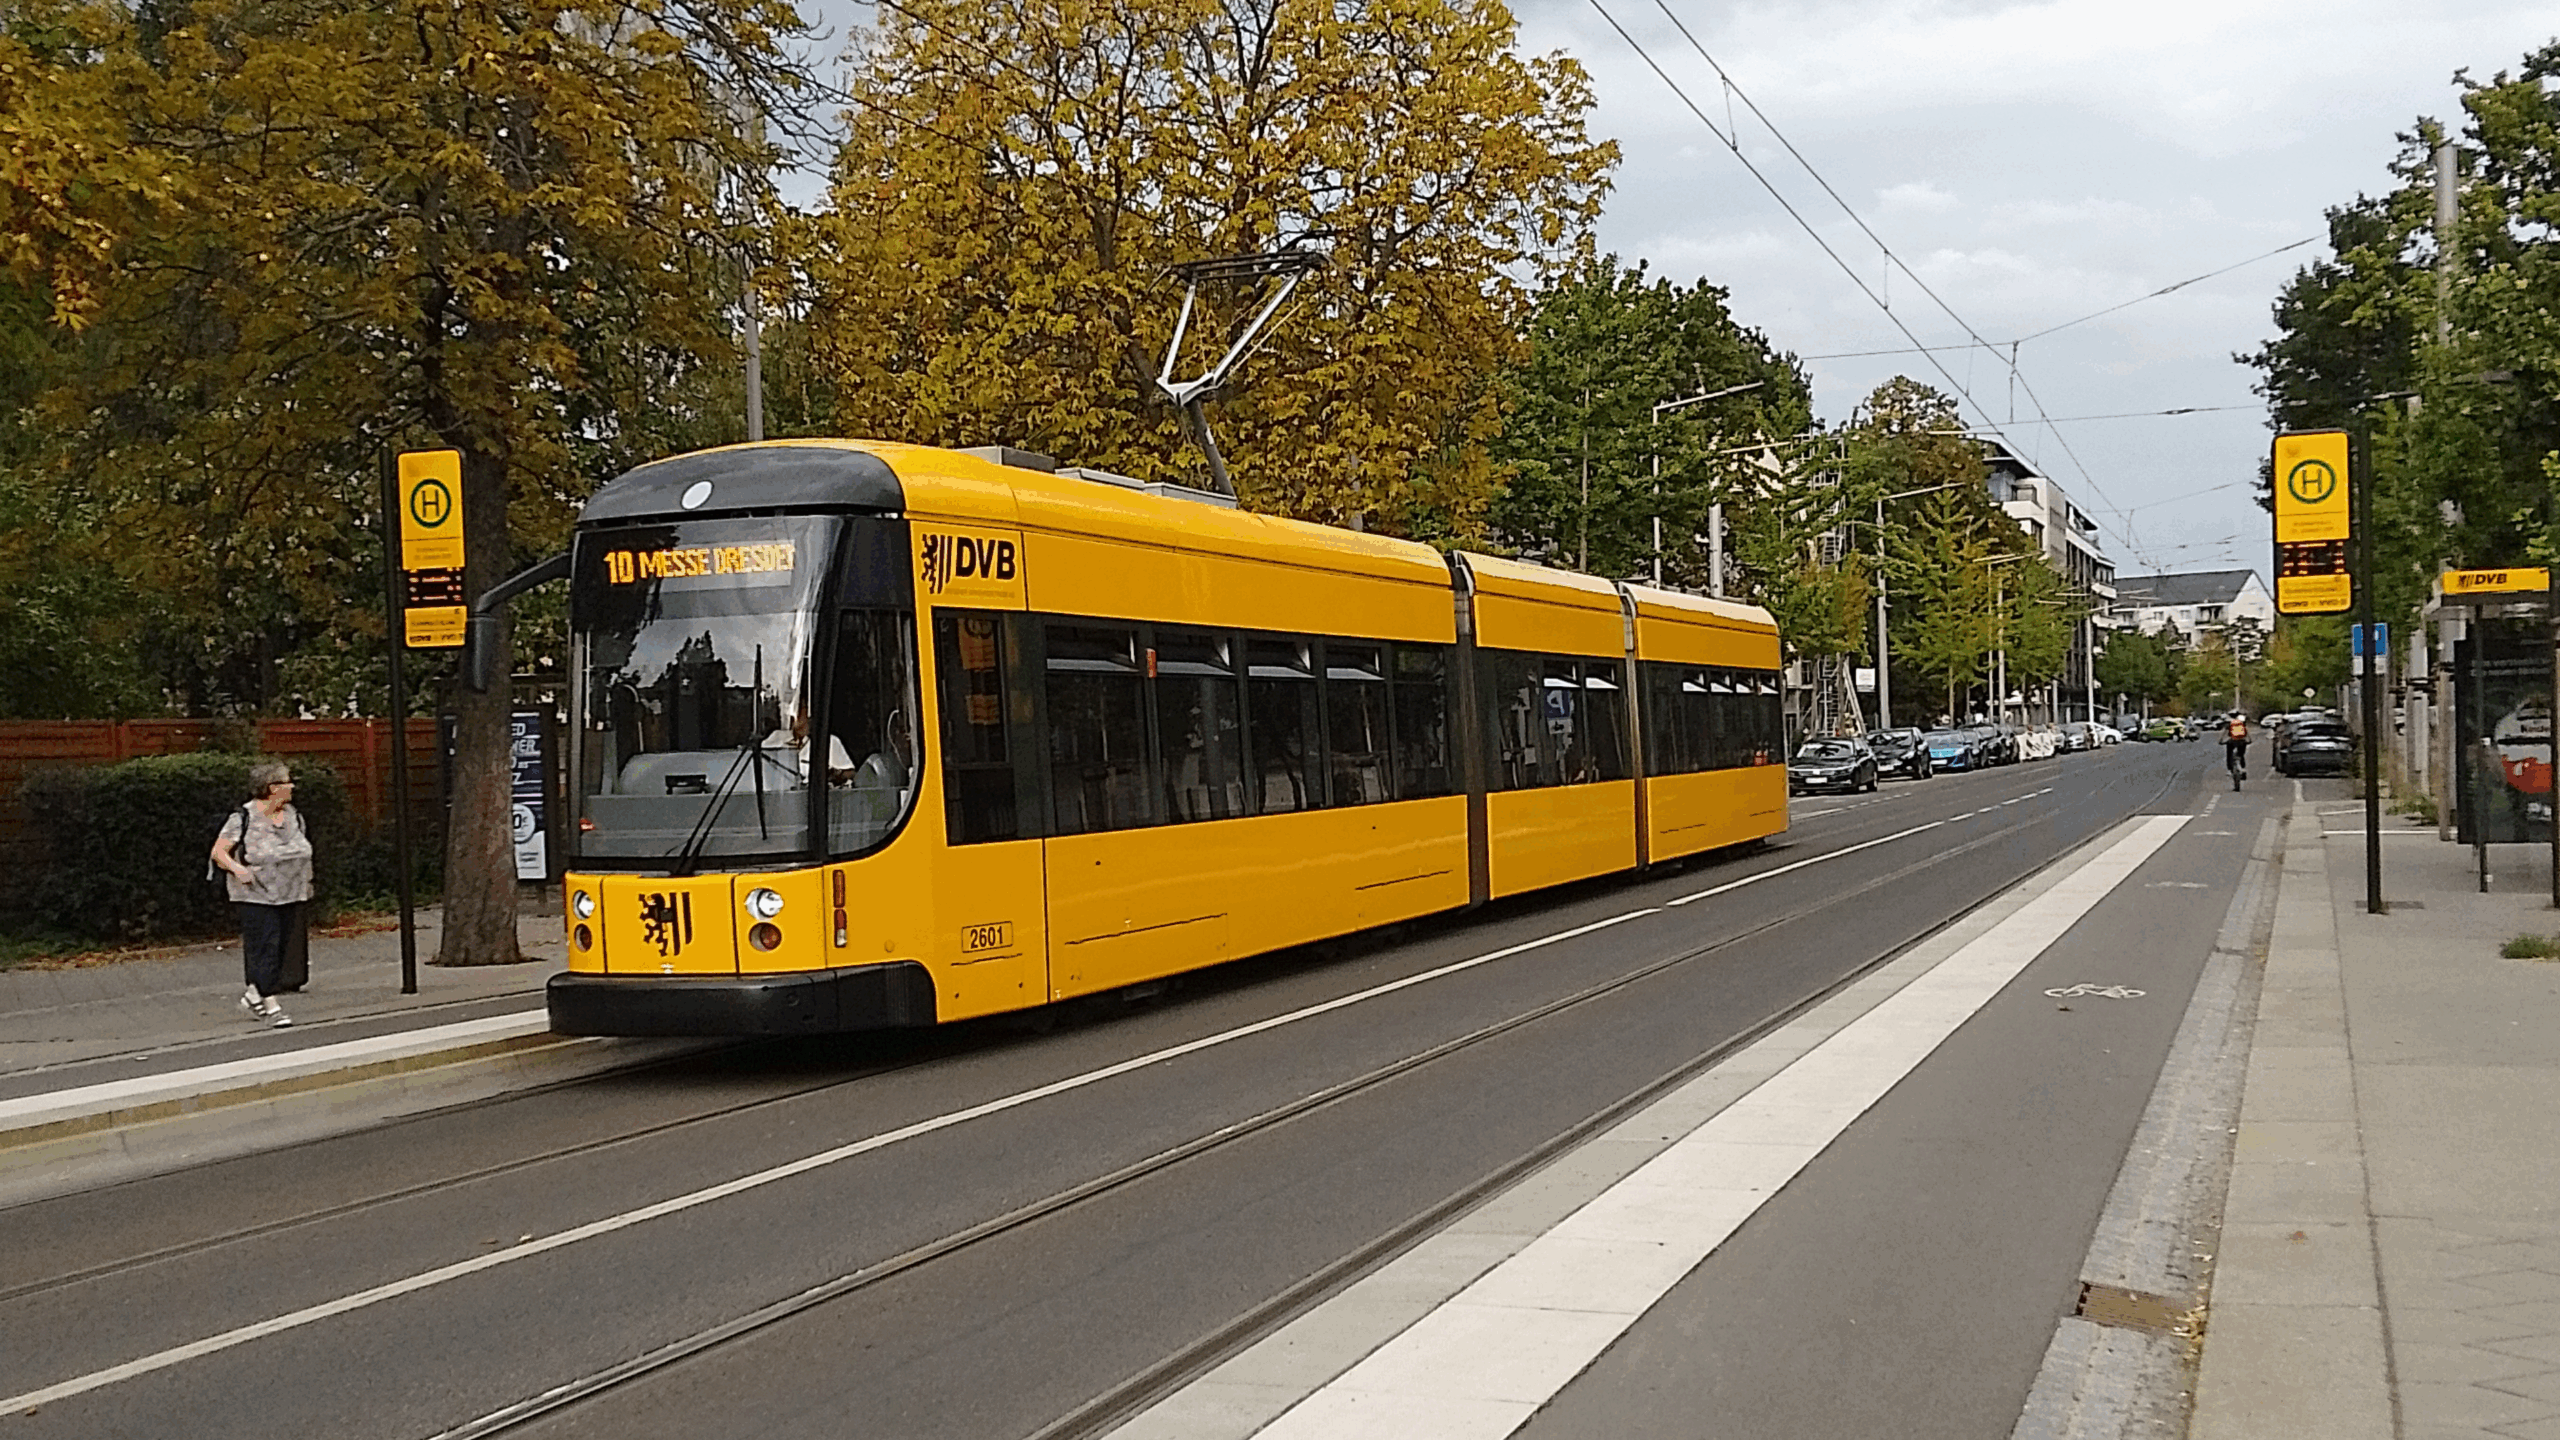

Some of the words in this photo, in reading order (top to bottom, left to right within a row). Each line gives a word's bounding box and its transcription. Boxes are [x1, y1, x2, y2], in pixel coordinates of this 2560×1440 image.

[2302, 469, 2323, 495] H
[421, 489, 440, 518] H
[603, 551, 635, 584] 10
[638, 547, 712, 579] MESSE
[955, 536, 1016, 580] DVB
[2474, 573, 2507, 585] DVB
[970, 926, 1003, 949] 2601
